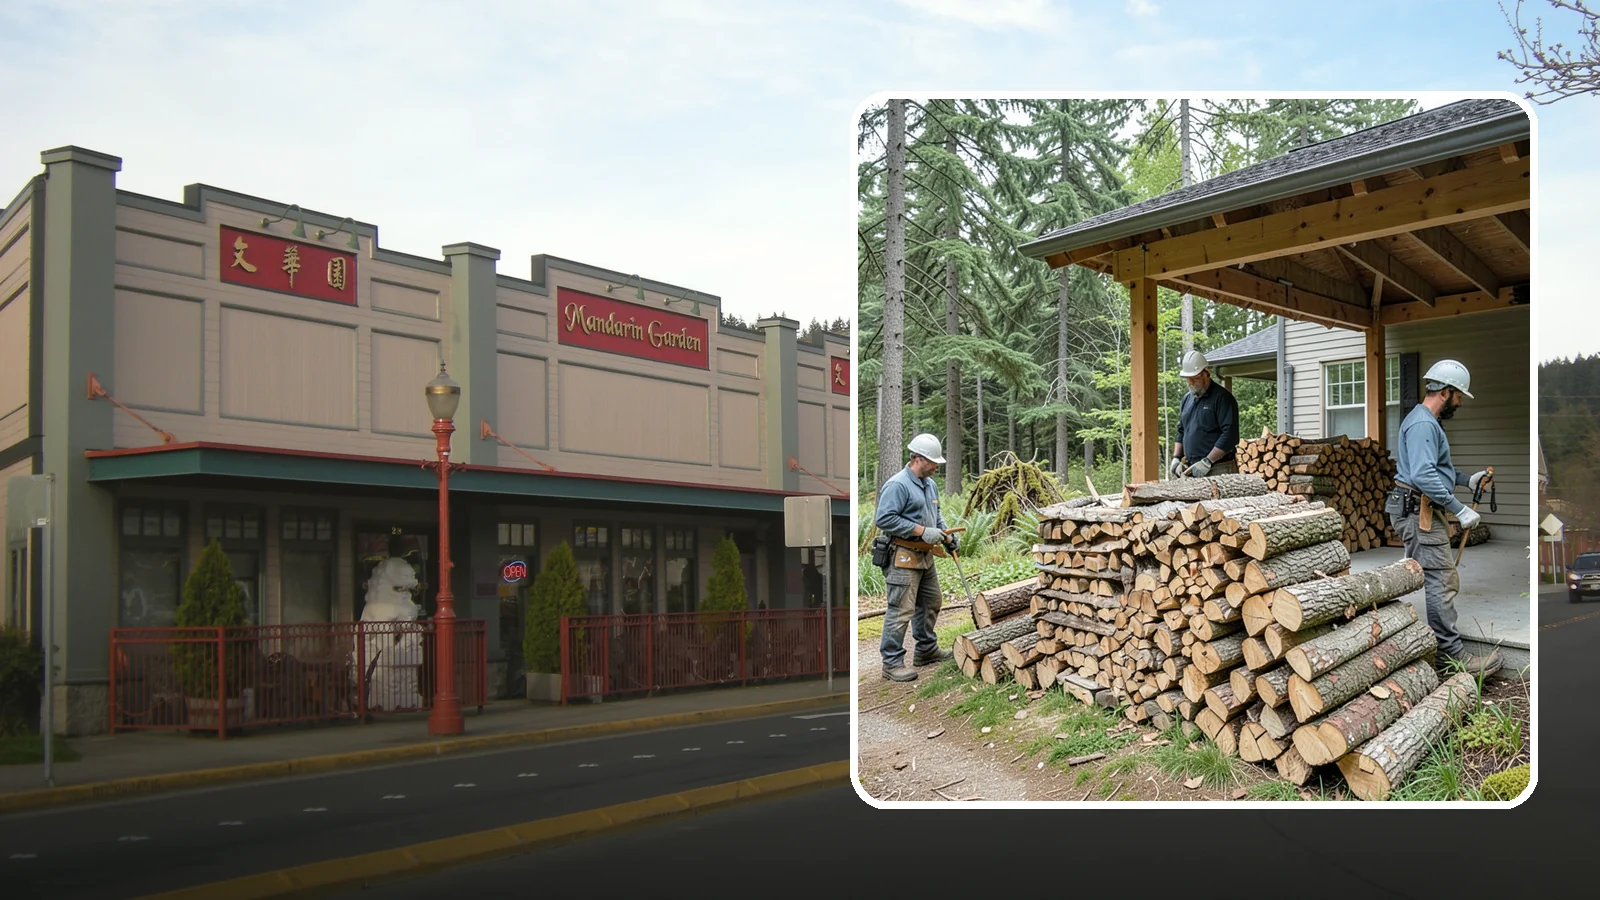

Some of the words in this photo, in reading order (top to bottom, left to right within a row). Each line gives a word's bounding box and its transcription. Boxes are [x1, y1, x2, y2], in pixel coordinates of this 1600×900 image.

[231, 236, 346, 291] 文華園
[564, 302, 644, 341] Mandarin
[647, 320, 702, 352] Garden
[503, 565, 527, 578] OPEN
